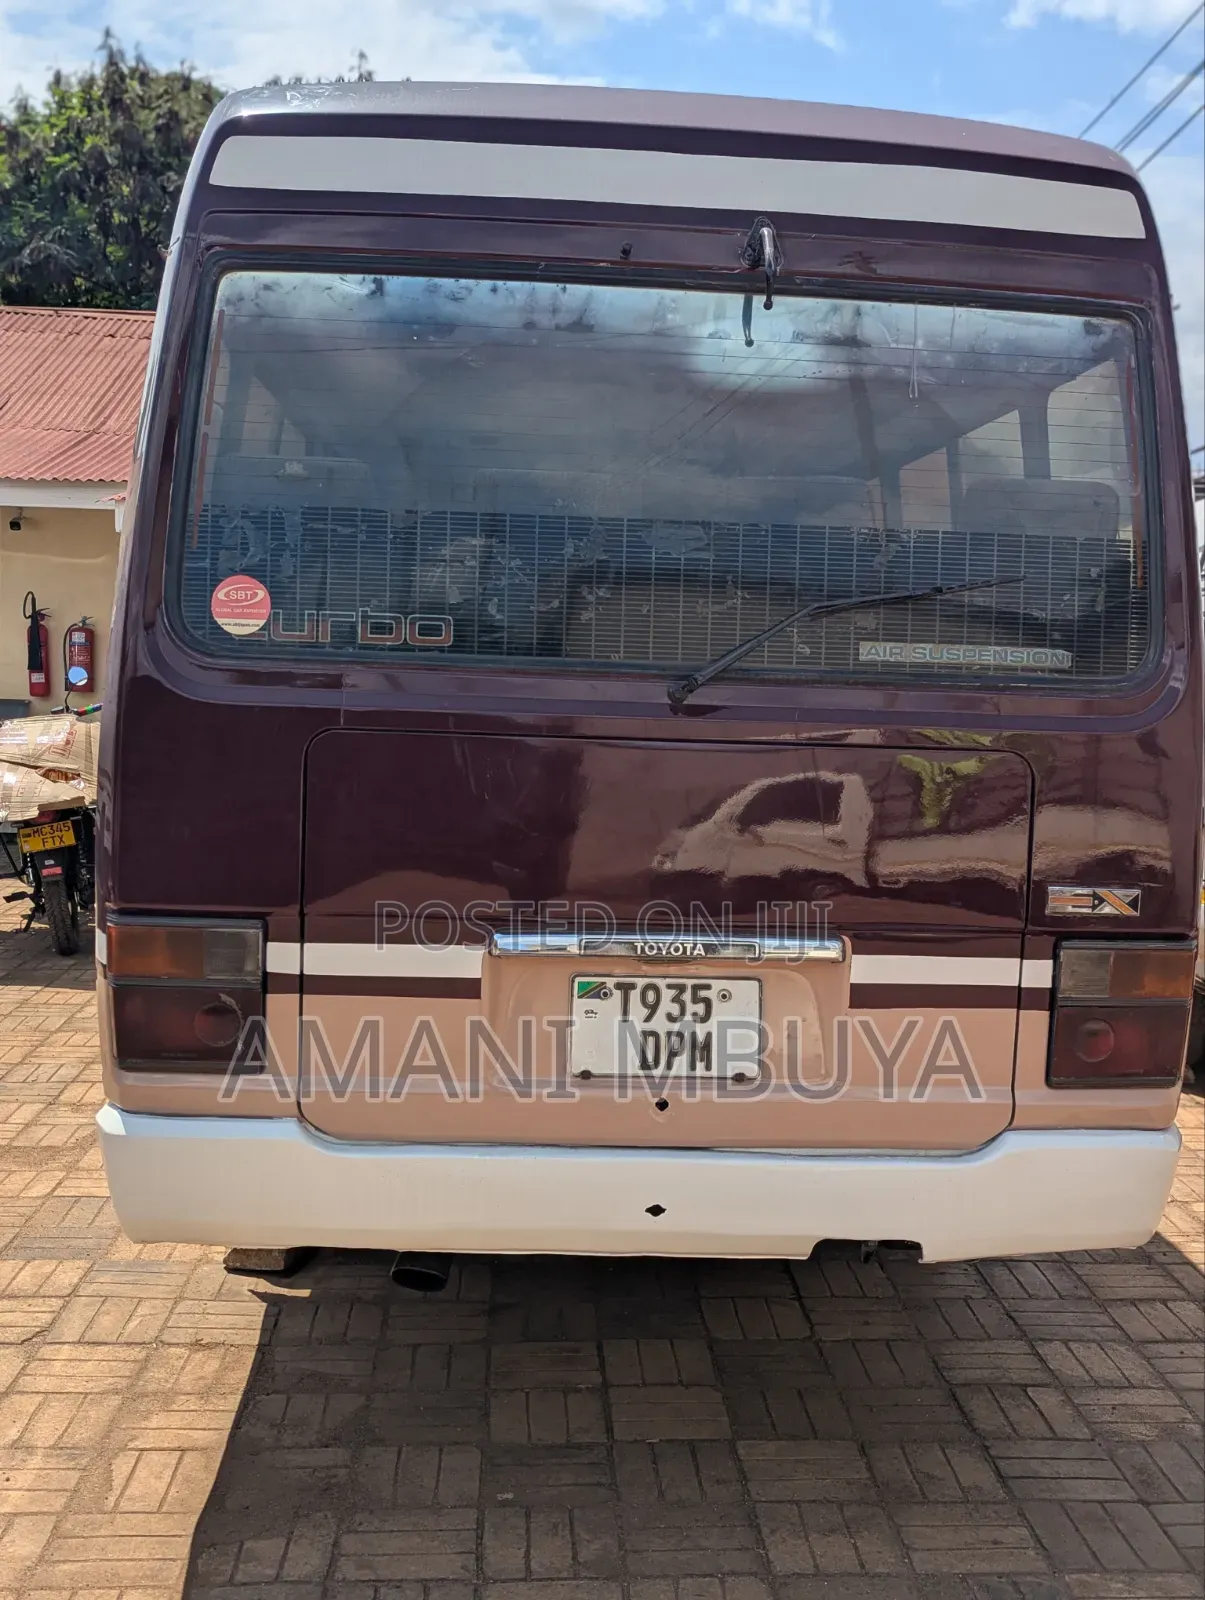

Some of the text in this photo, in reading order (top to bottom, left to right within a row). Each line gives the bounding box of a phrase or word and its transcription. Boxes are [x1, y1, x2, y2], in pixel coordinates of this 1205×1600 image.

[229, 590, 253, 600] SBT
[233, 607, 454, 647] urbo
[863, 645, 1067, 666] AIR SUSPENSION
[32, 822, 71, 839] MC345
[41, 834, 66, 848] FTX
[634, 942, 707, 957] TOYOTA
[613, 981, 714, 1024] T935
[639, 1029, 714, 1072] DPM
